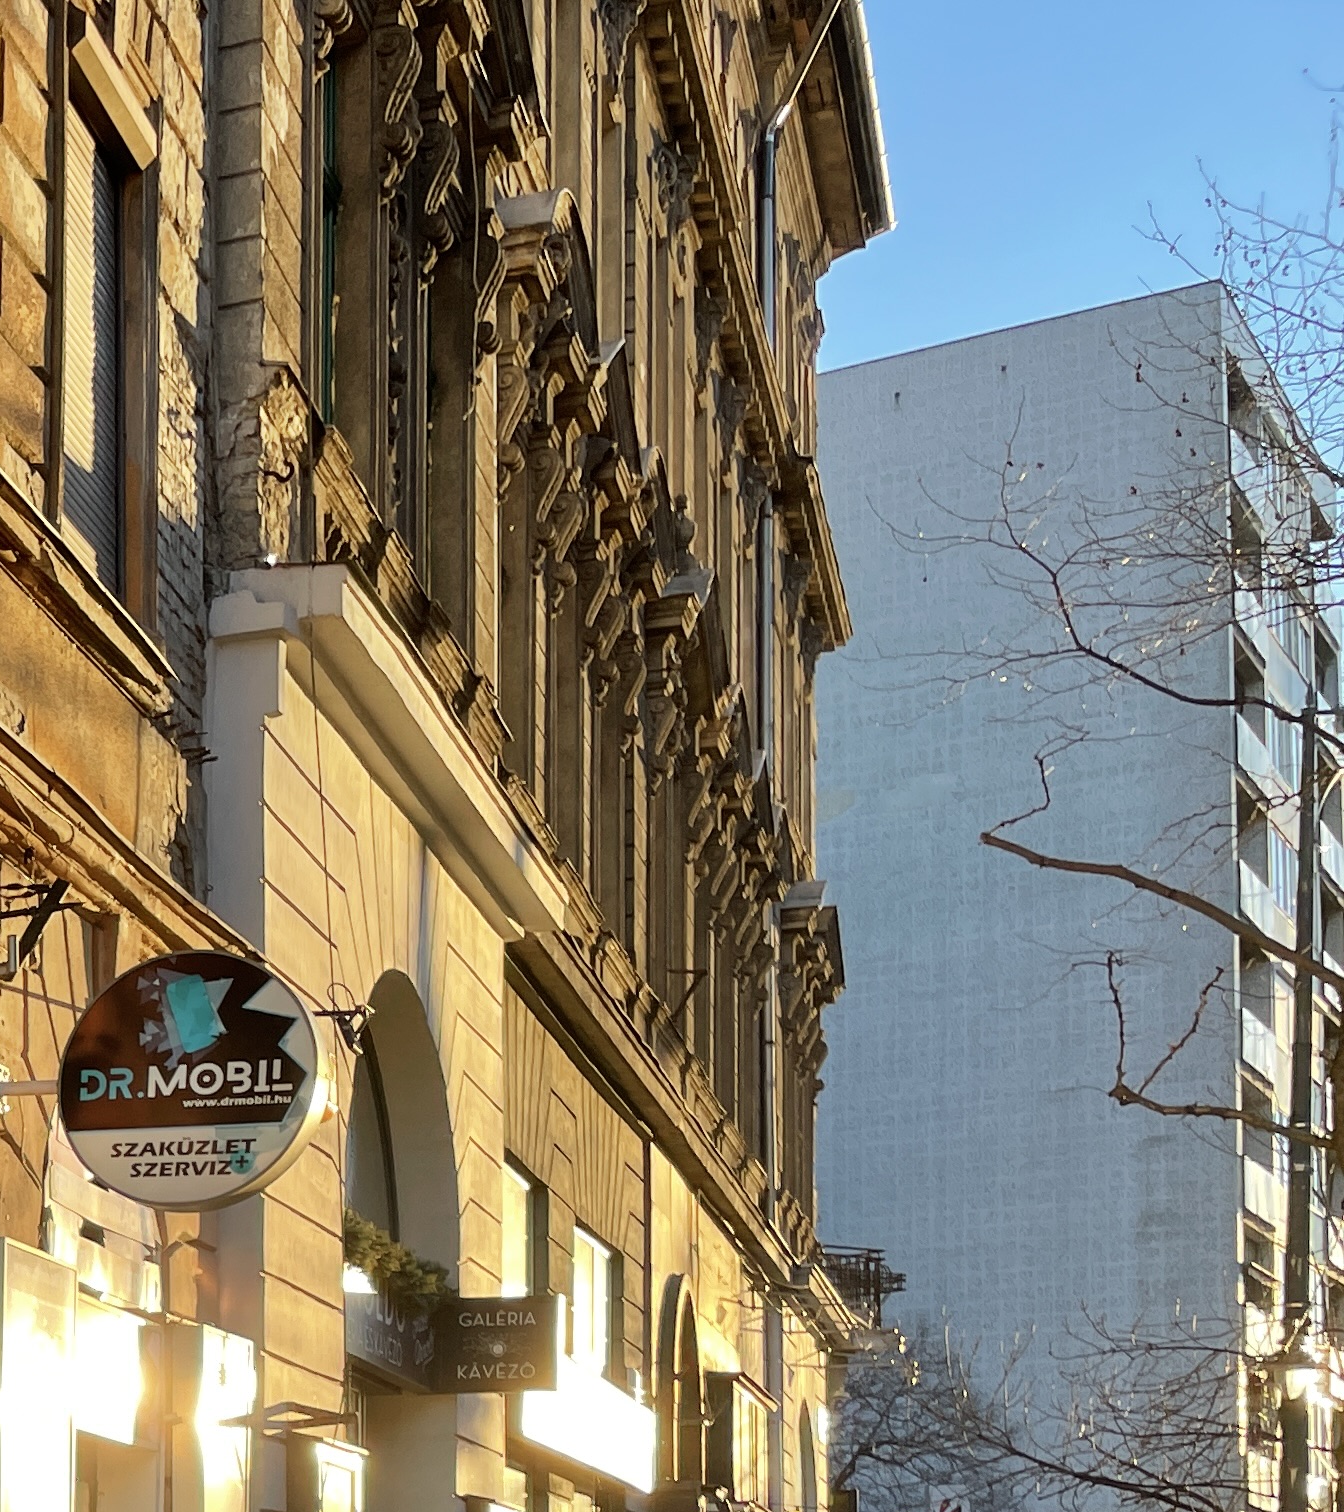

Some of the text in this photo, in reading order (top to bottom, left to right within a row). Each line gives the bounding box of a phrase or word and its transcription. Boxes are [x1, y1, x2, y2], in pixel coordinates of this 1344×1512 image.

[79, 1058, 294, 1102] DR.MOBIL
[182, 1094, 292, 1109] www.drmobil.hu
[110, 1137, 257, 1158] SZAKÜZLET
[130, 1159, 234, 1178] SZERVIZ
[458, 1310, 537, 1328] GALÉRIA
[457, 1361, 536, 1380] KÁVÉZÓ
